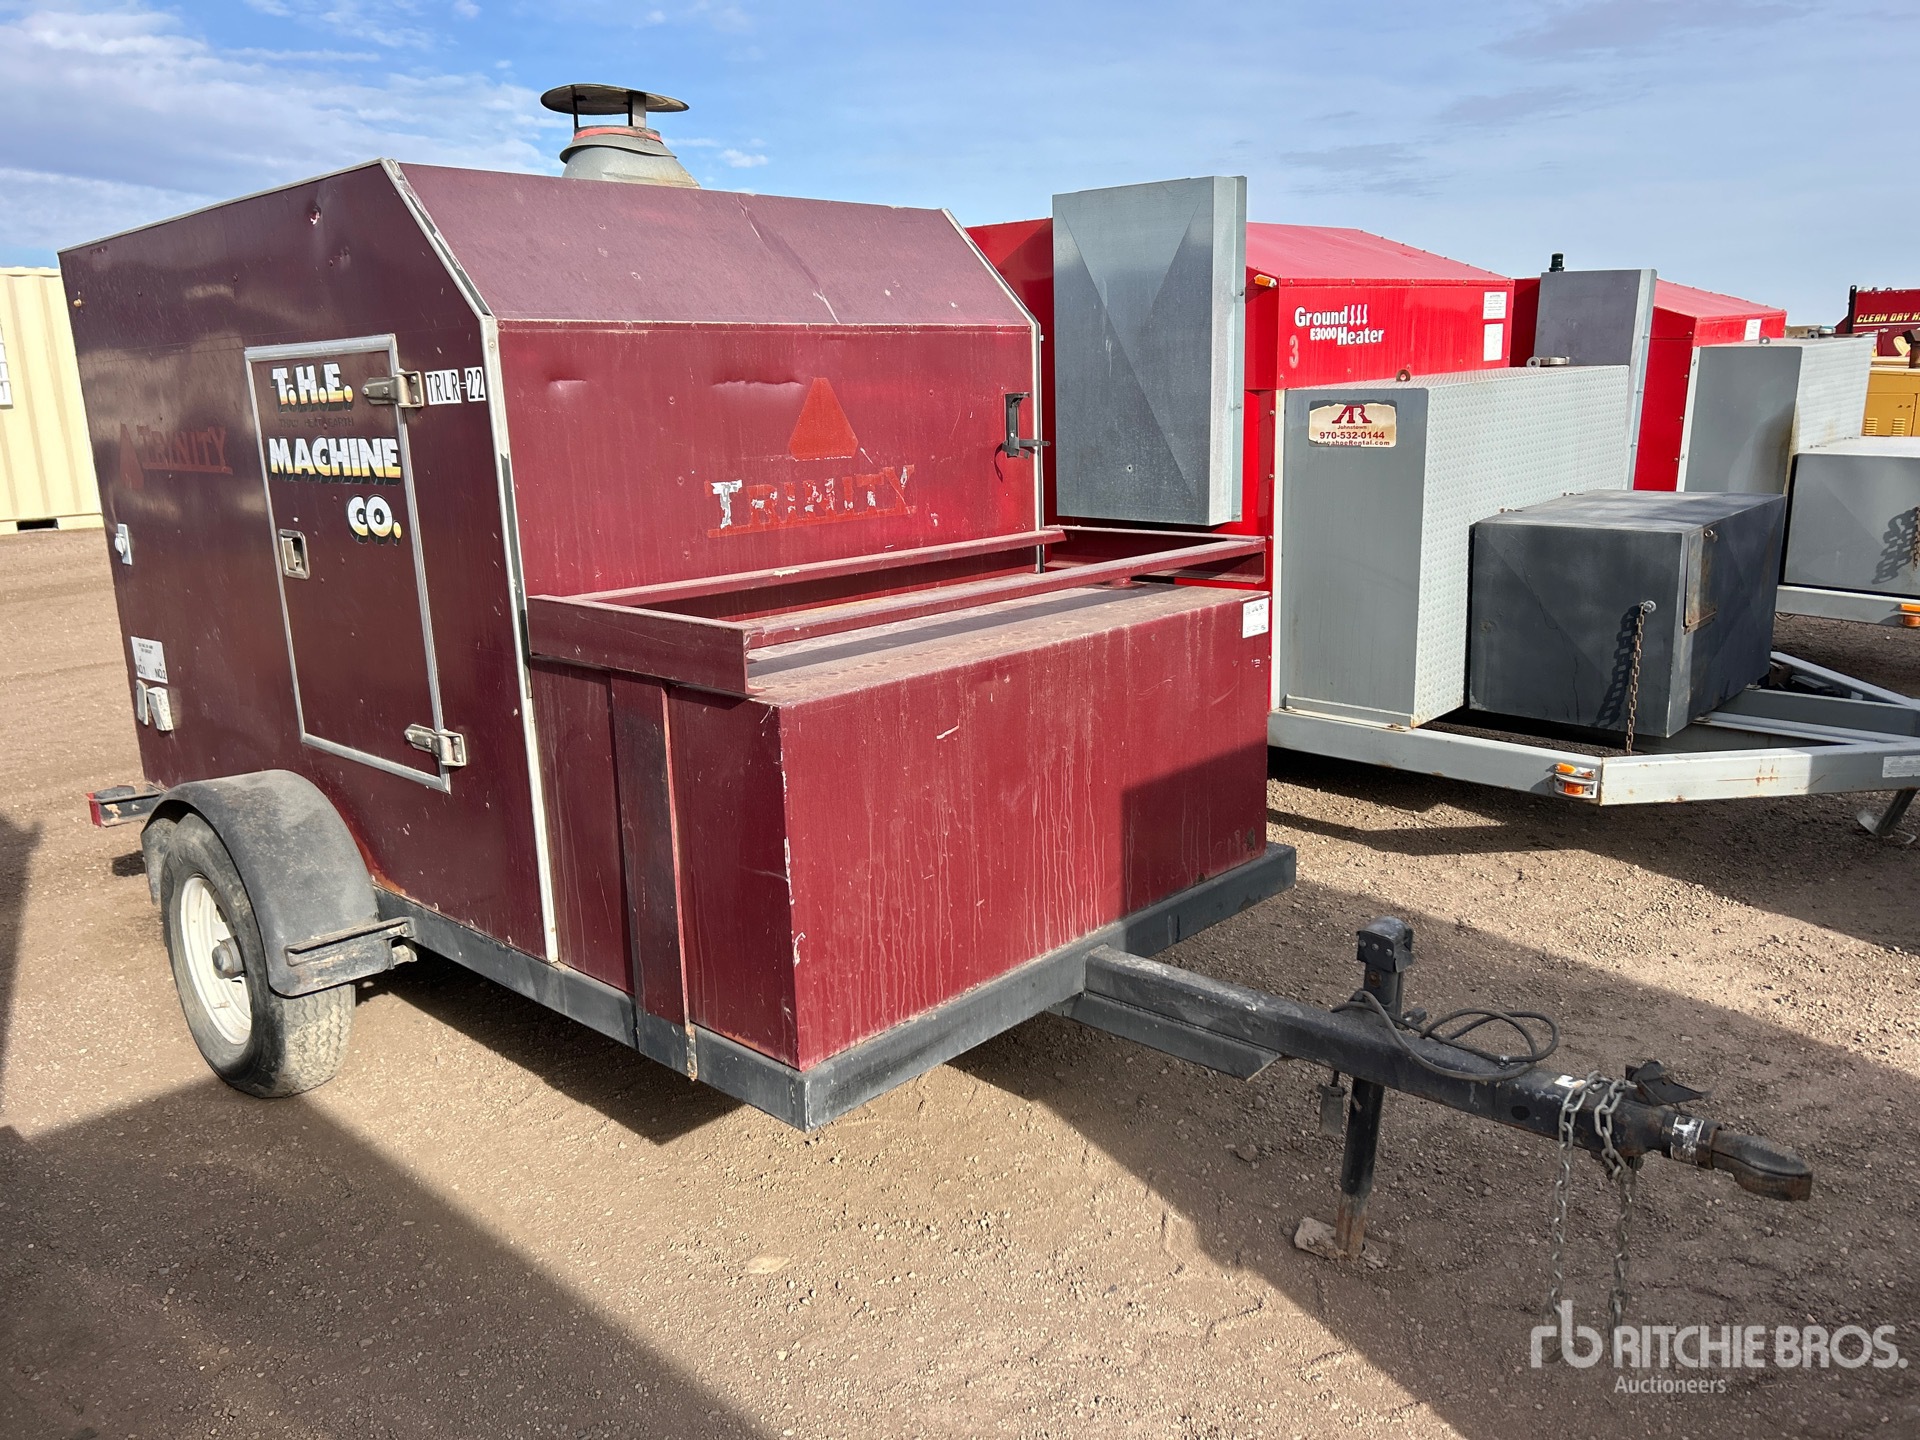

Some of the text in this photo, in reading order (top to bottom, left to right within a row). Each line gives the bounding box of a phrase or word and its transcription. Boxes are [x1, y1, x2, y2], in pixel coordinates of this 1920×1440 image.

[1294, 306, 1349, 328] Ground
[1857, 313, 1888, 323] CLEAN
[1890, 312, 1911, 322] DRY
[1309, 326, 1385, 346] E3000 Heater
[1289, 335, 1300, 369] 3
[271, 361, 355, 410] T.H.E.
[1319, 431, 1386, 440] 970-532-0144
[268, 435, 402, 482] MACHINE
[346, 494, 403, 543] CO.
